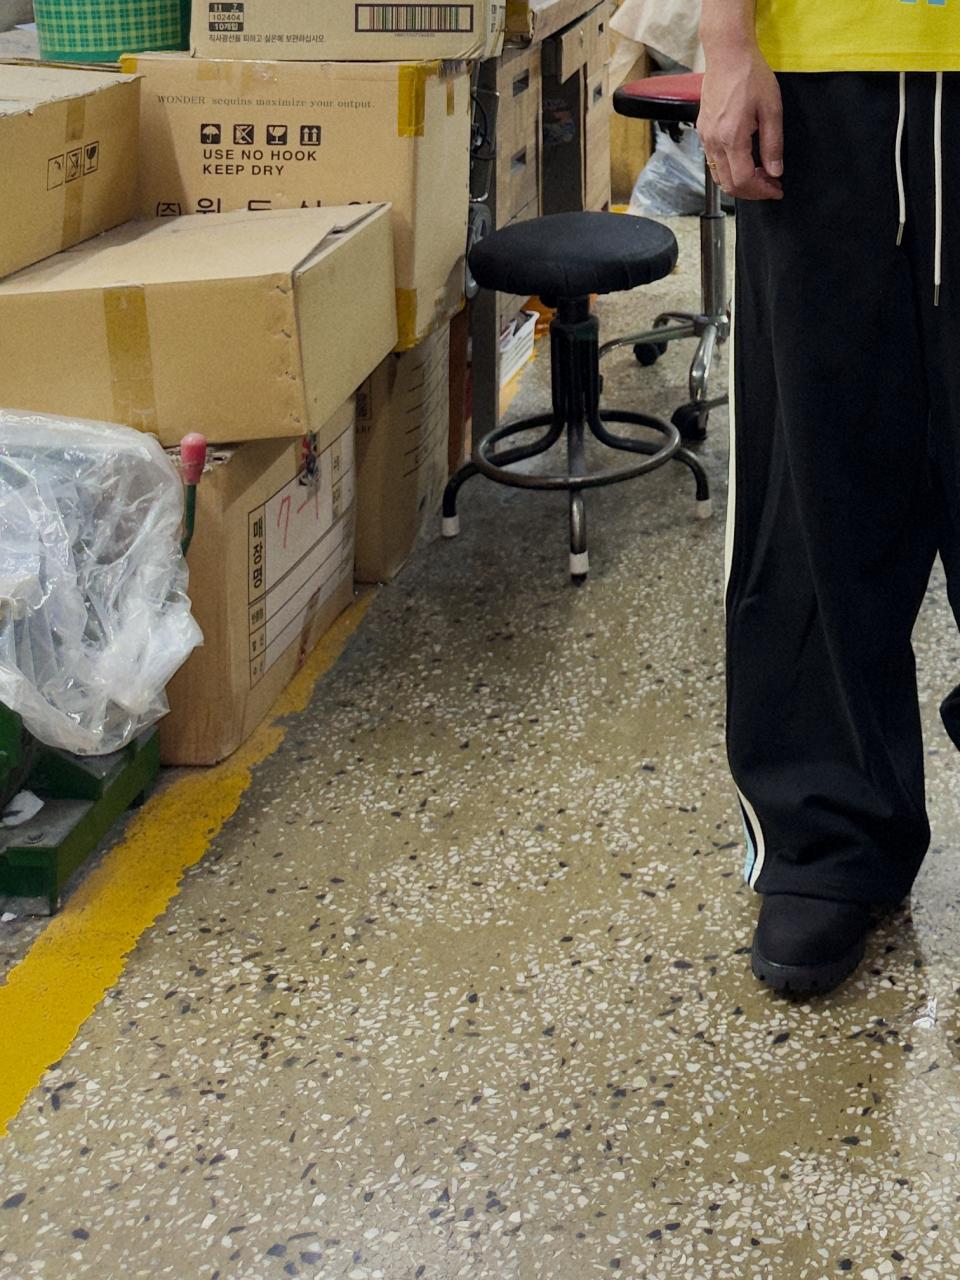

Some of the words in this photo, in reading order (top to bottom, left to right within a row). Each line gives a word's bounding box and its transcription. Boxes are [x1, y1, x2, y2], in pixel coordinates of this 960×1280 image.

[156, 94, 206, 105] WONDER
[310, 100, 334, 109] your
[203, 149, 235, 160] USE
[242, 150, 264, 160] NO
[271, 150, 318, 161] HOOK
[203, 164, 245, 175] KEEP
[251, 165, 285, 176] DRY
